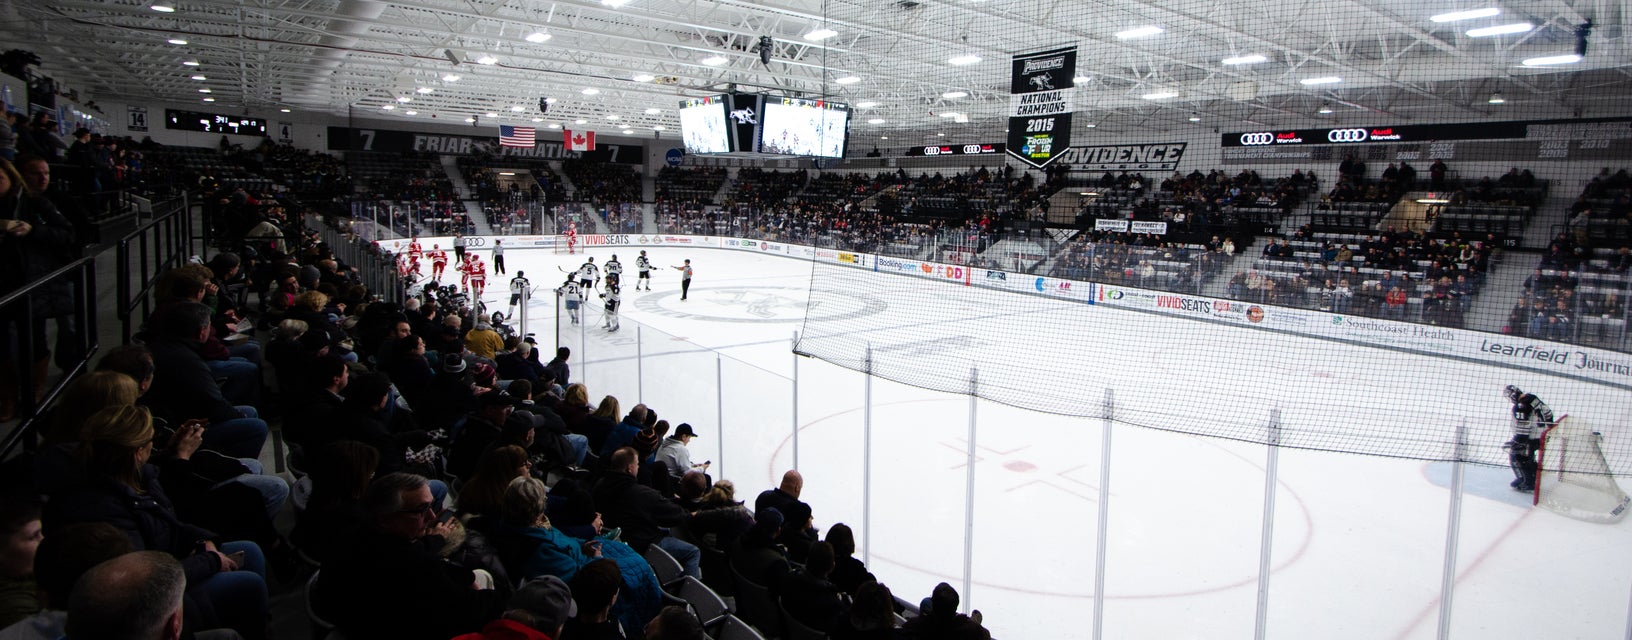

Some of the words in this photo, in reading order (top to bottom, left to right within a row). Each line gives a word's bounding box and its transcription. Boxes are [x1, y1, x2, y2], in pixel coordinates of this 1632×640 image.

[1020, 91, 1062, 105] NATIONAL
[1017, 101, 1066, 115] CHAMPIONS
[131, 113, 144, 126] 14
[1026, 118, 1055, 132] 2015
[282, 126, 288, 139] 4
[359, 130, 375, 151] 7
[414, 135, 473, 154] FRIAR
[608, 145, 619, 162] 7
[1057, 144, 1183, 163] OVIDENCE
[879, 258, 916, 270] Booking.com
[568, 286, 578, 294] 21
[1346, 317, 1407, 334] Southcoast
[1413, 326, 1454, 341] Health
[1480, 339, 1568, 364] Learfield
[1574, 351, 1632, 376] Journa
